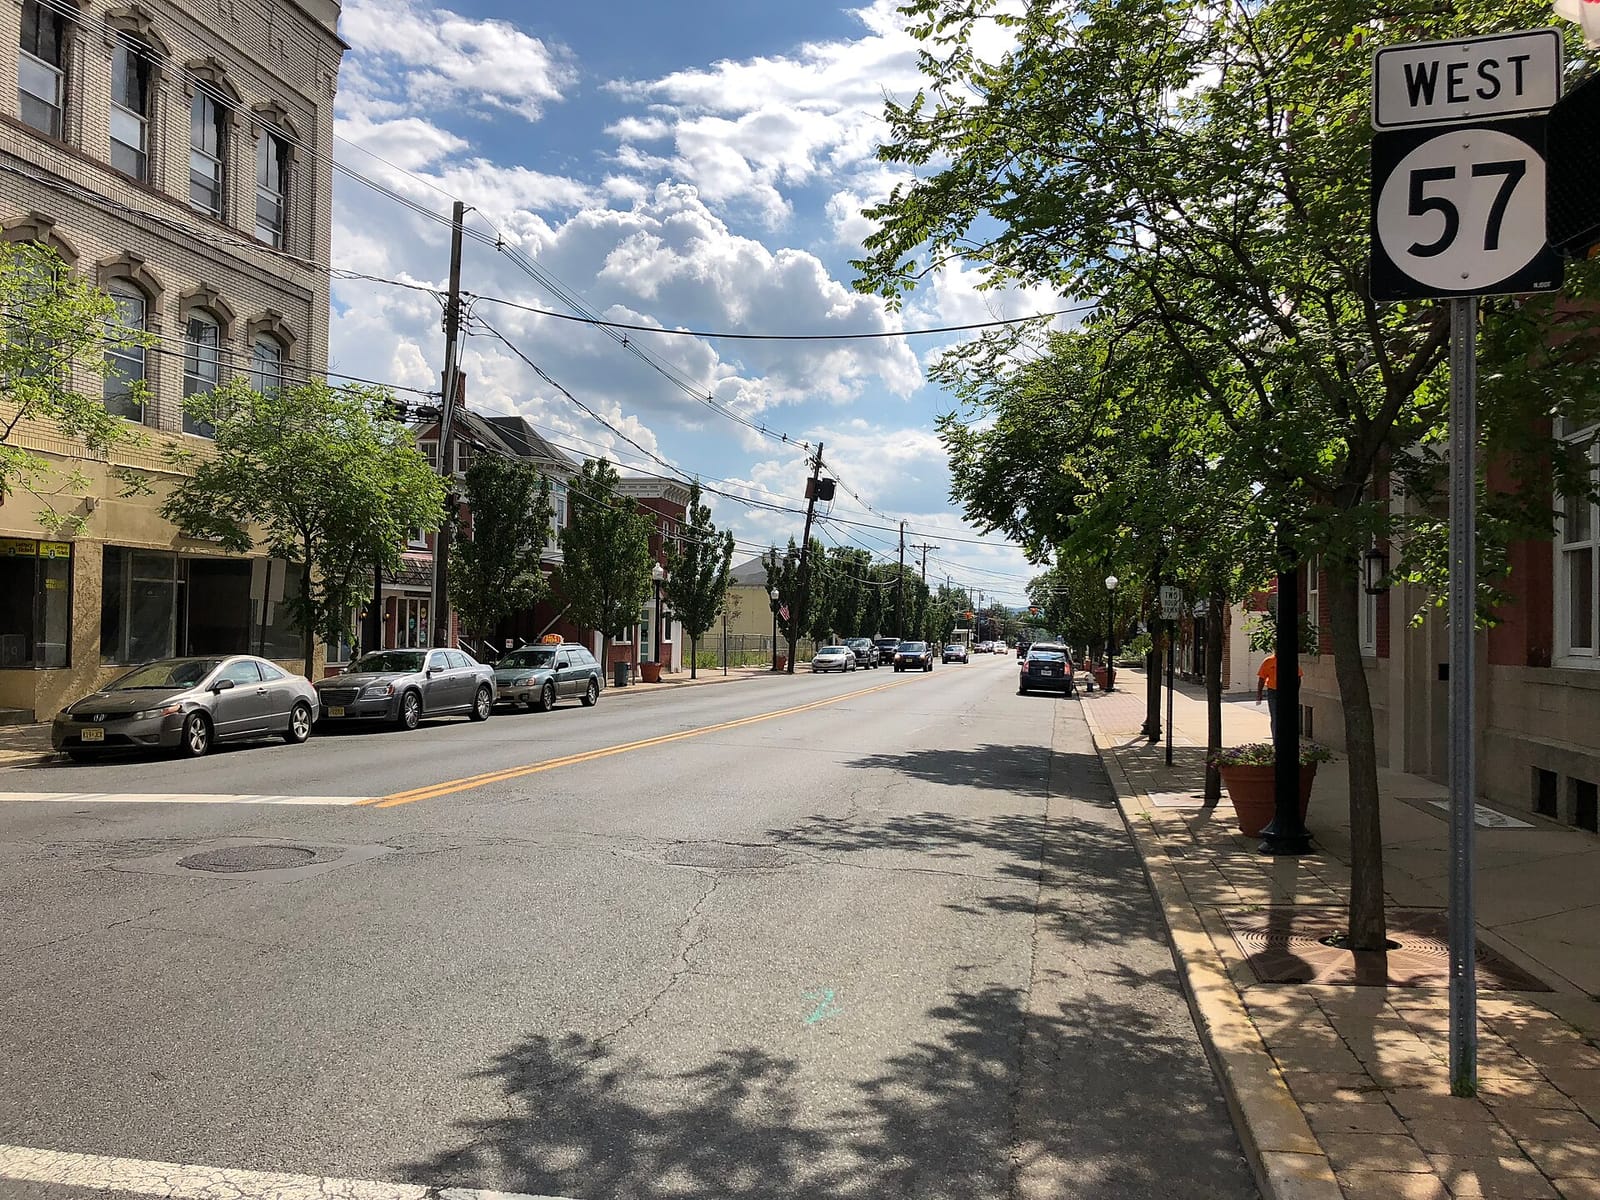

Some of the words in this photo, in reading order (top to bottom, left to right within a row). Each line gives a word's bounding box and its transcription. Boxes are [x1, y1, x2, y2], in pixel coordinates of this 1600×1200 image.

[1403, 54, 1531, 108] WEST
[1406, 159, 1527, 258] 57
[1165, 591, 1177, 599] TWO
